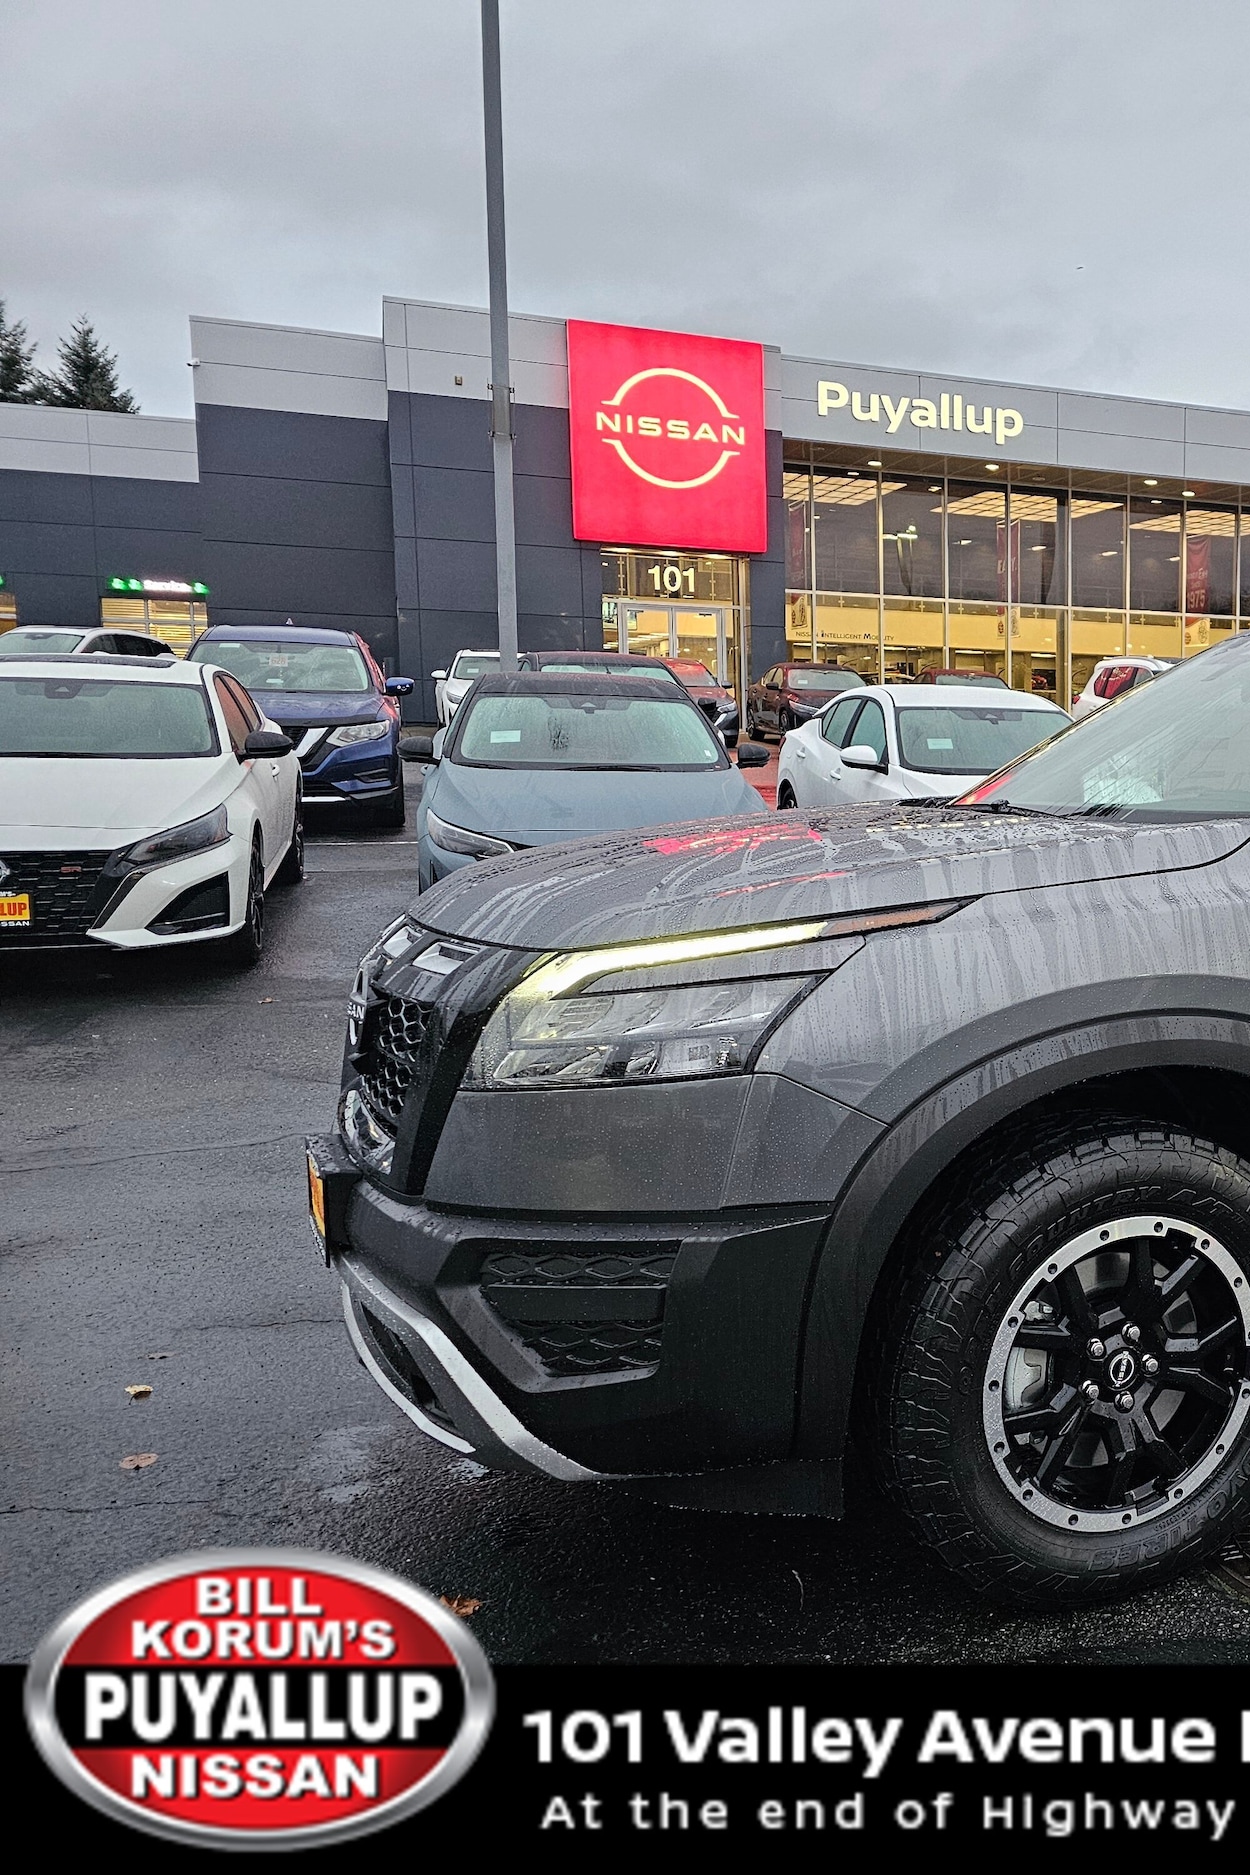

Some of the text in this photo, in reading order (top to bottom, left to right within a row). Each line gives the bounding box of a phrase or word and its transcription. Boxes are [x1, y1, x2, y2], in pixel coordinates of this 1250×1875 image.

[596, 411, 746, 445] NISSAN
[816, 380, 1024, 444] Puyallup
[647, 564, 695, 593] 101
[795, 630, 819, 638] NISSN
[1087, 1513, 1201, 1572] TIRES
